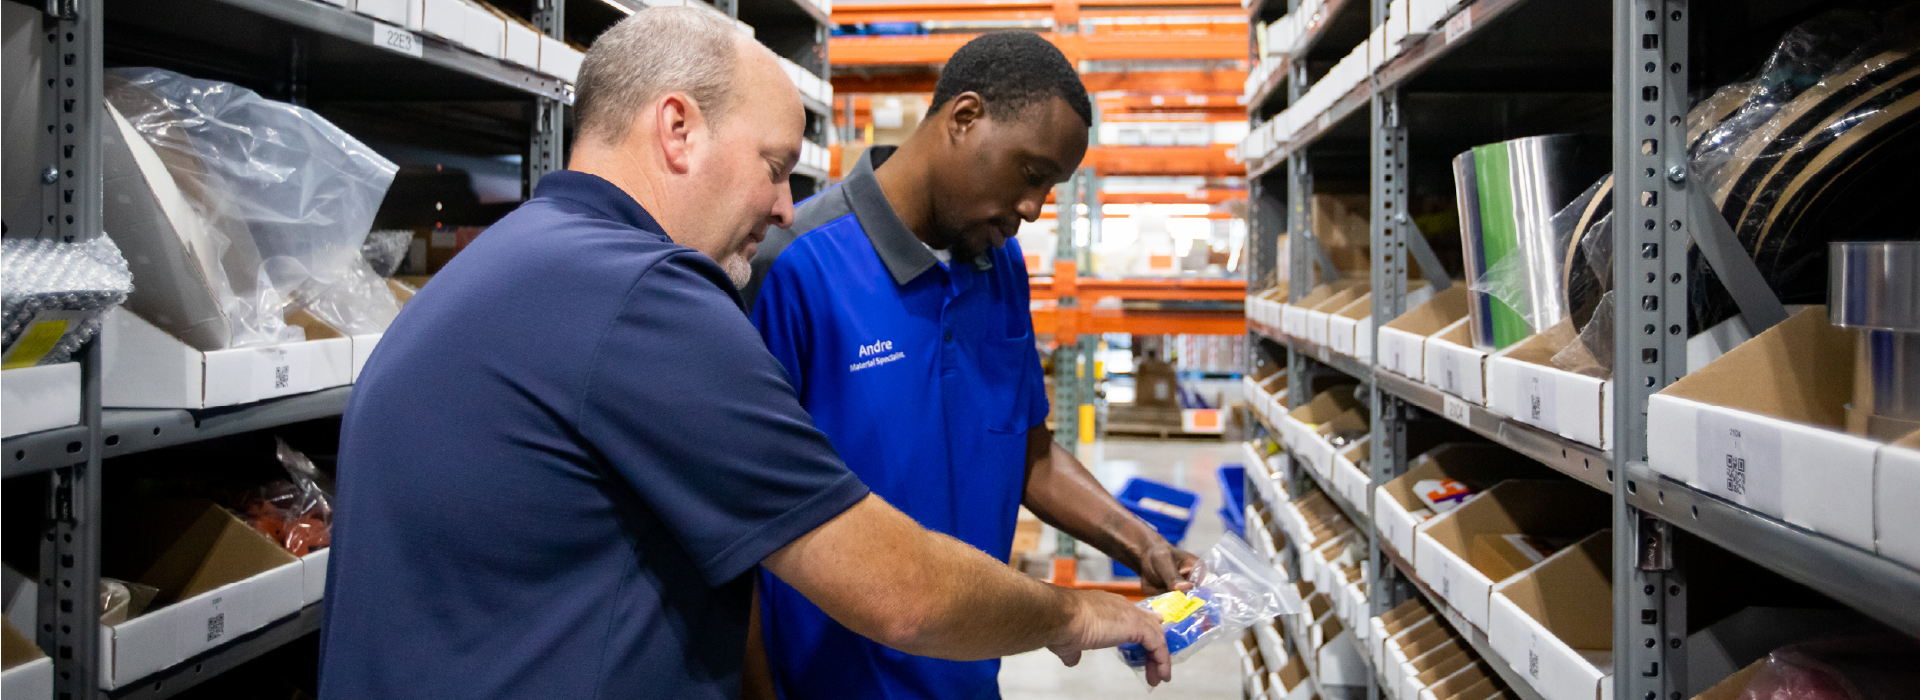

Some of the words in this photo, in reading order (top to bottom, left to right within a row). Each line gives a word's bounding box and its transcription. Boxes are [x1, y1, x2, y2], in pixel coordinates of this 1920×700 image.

[387, 30, 412, 51] 22E3
[859, 339, 893, 358] Andre
[850, 358, 876, 372] Material
